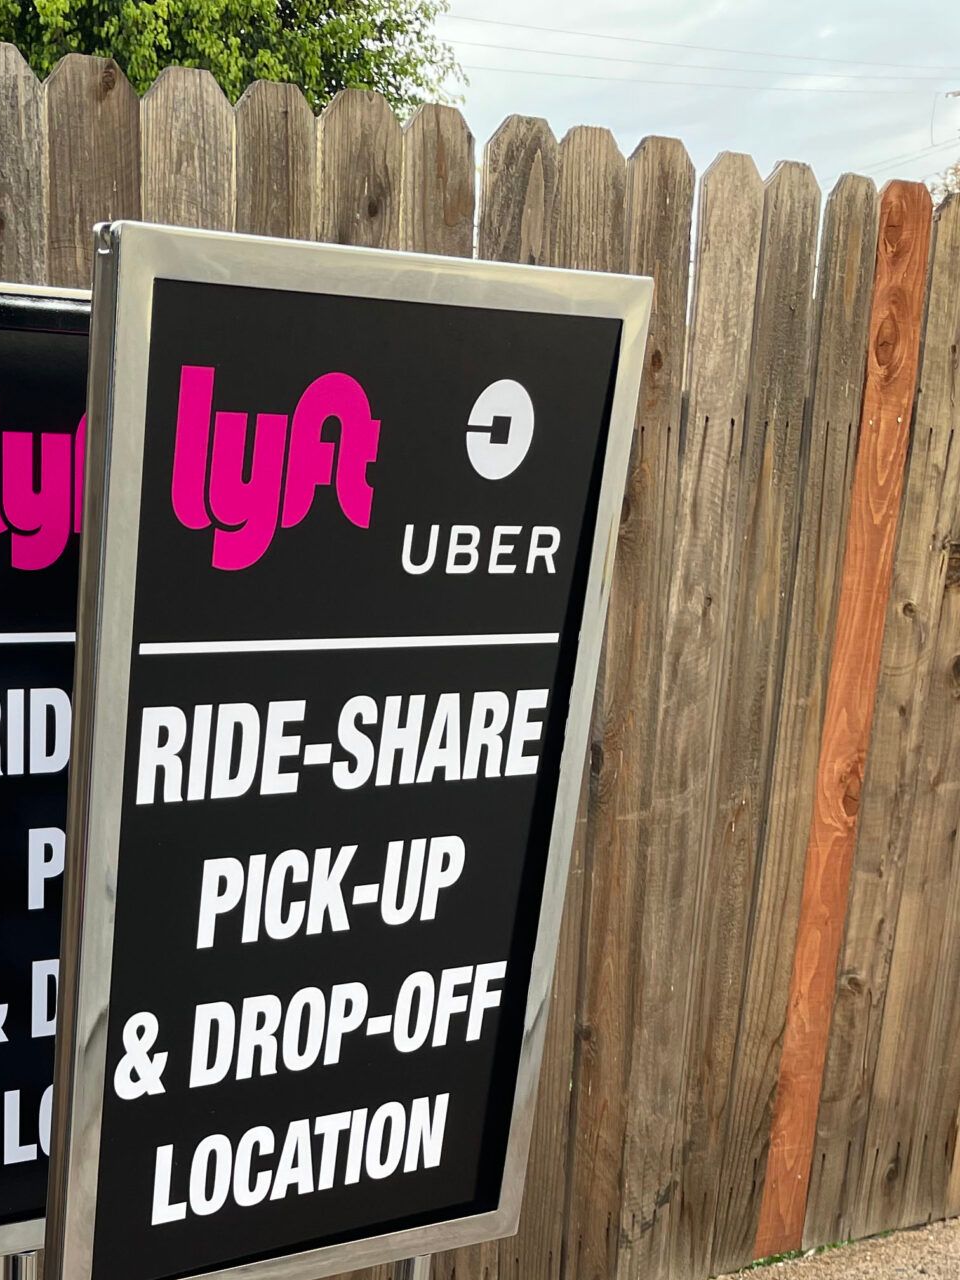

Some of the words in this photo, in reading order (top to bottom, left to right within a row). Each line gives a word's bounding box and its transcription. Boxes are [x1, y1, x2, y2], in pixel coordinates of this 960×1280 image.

[171, 366, 381, 571] lyft
[401, 524, 561, 575] UBER
[136, 689, 549, 805] RIDE-SHARE
[196, 835, 466, 949] PICK-UP
[114, 1012, 168, 1101] &
[189, 961, 508, 1088] DROP-OFF
[151, 1093, 450, 1226] LOCATION
